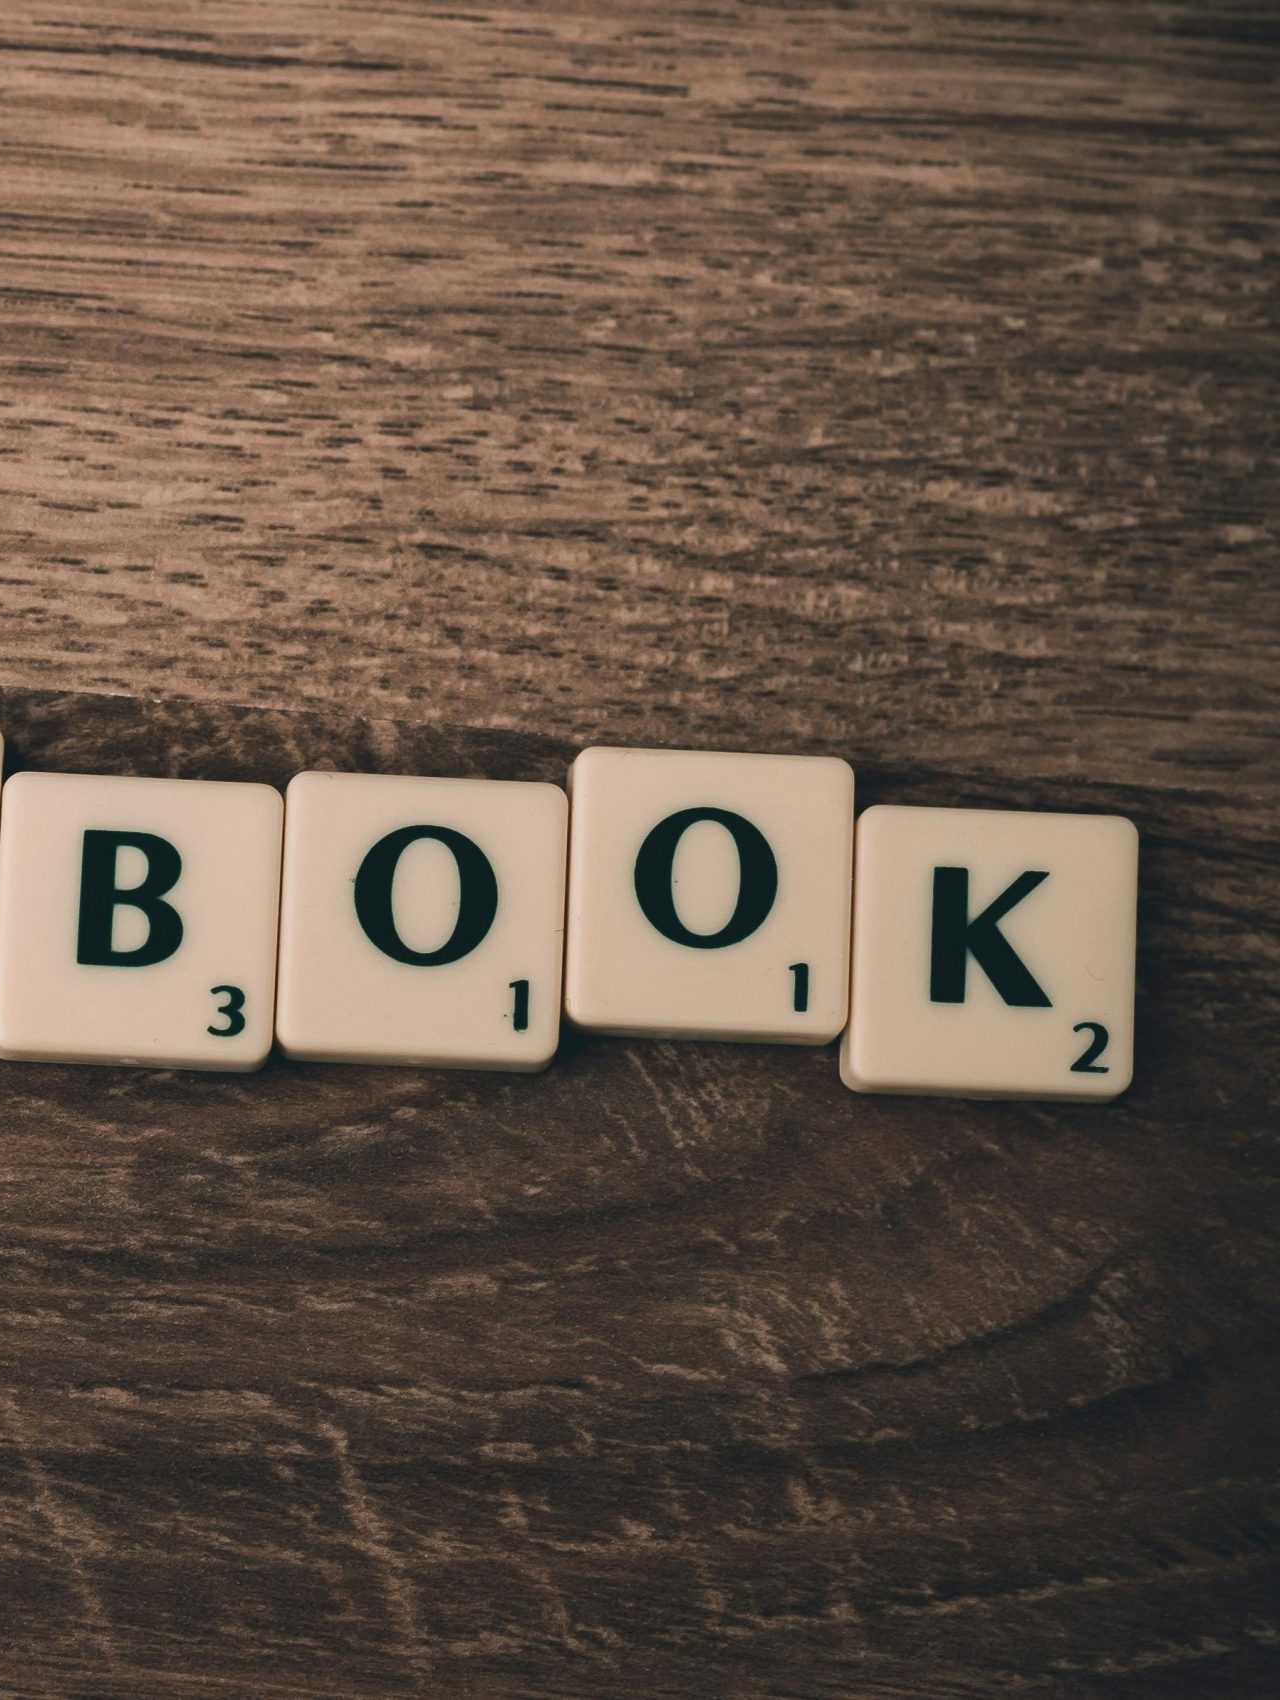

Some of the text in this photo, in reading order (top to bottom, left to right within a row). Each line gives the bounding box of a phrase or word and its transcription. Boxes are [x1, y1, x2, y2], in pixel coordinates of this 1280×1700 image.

[206, 984, 246, 1038] 3
[507, 978, 531, 1033] 1
[787, 962, 811, 1013] 1
[1069, 1021, 1110, 1075] 2
